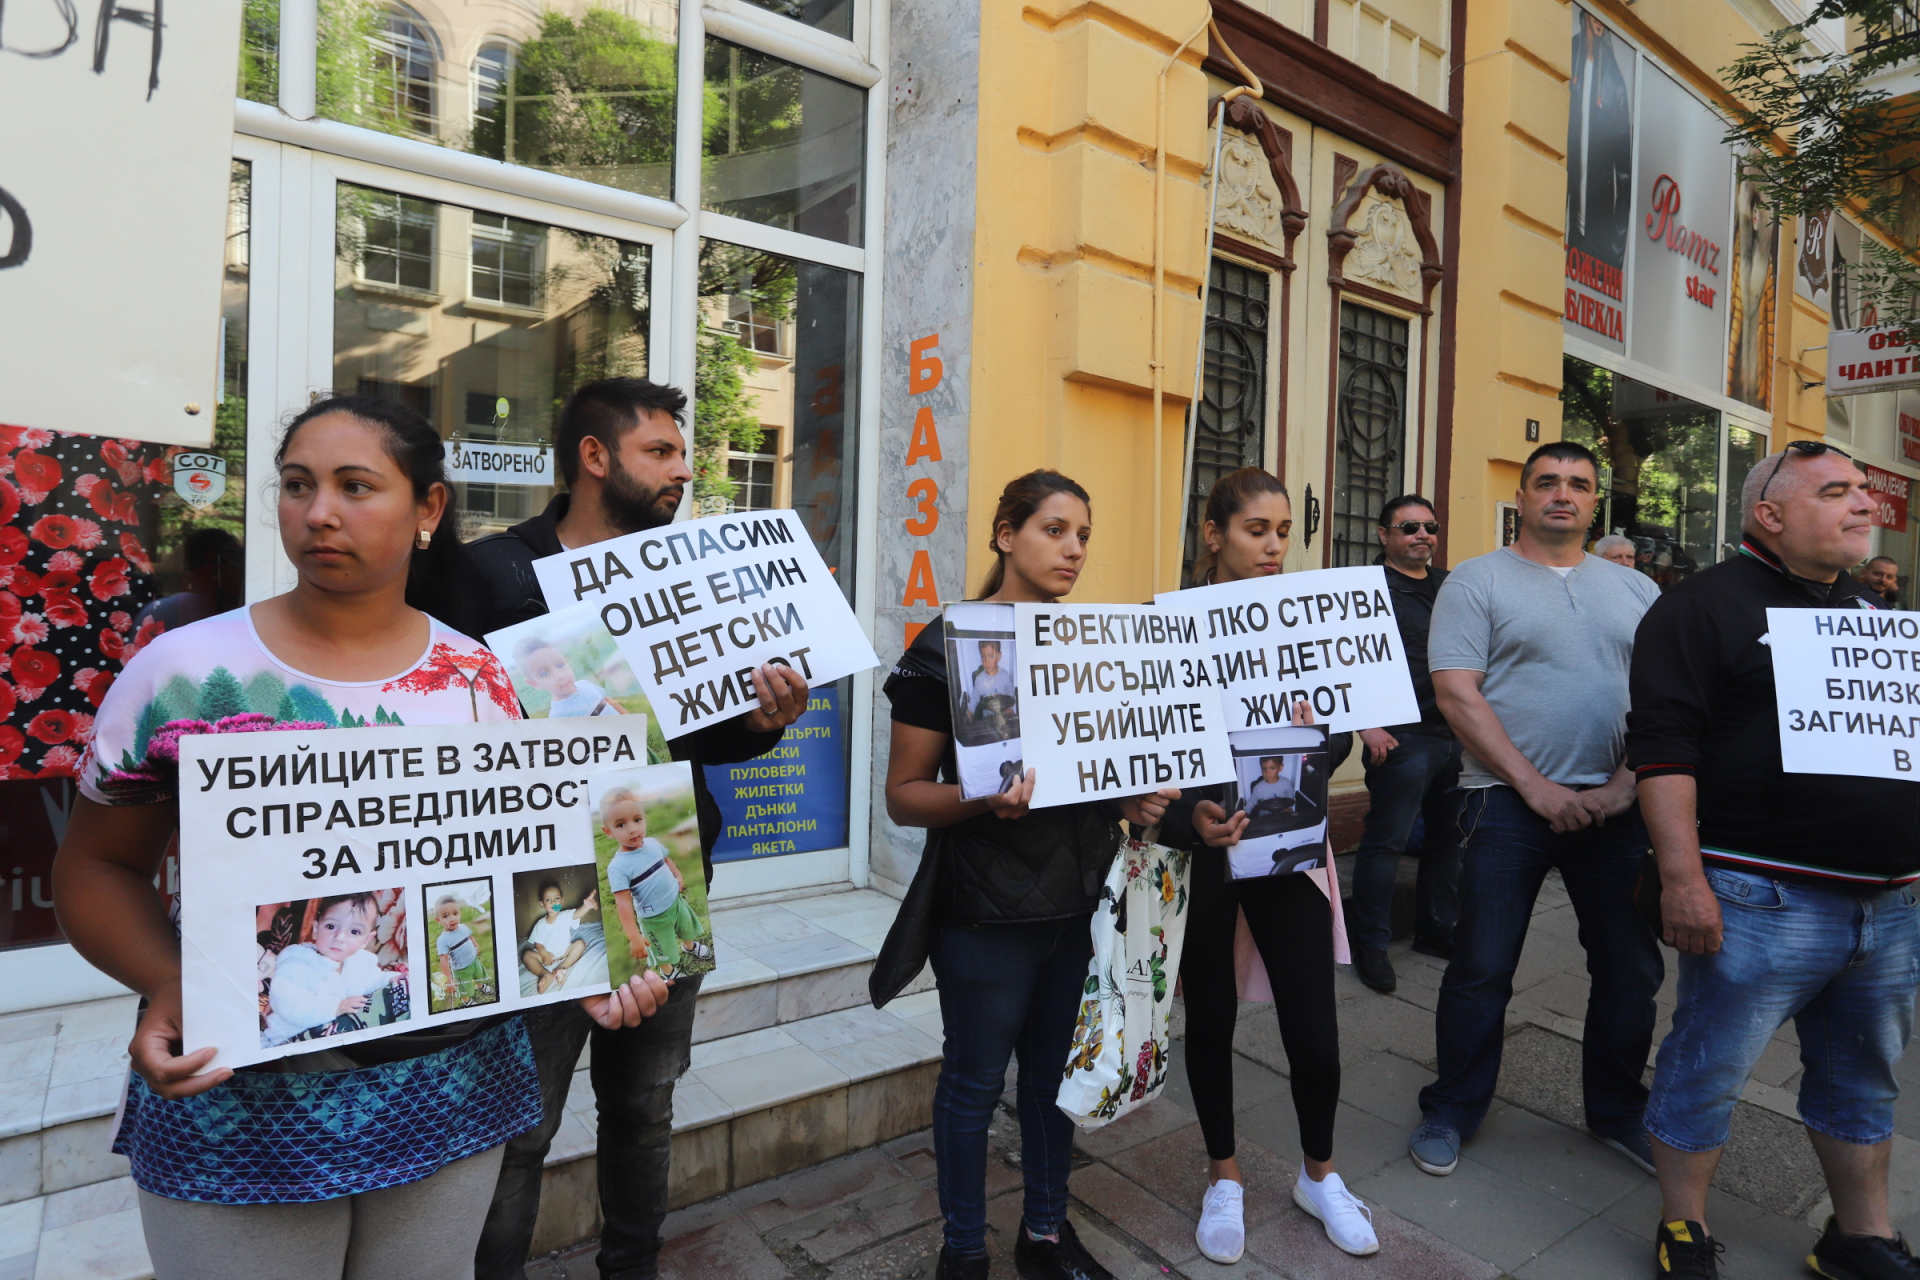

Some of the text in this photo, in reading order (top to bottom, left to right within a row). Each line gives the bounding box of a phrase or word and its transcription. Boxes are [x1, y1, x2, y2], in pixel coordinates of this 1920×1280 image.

[1646, 174, 1720, 275] Ramz
[1686, 276, 1716, 308] star
[1565, 287, 1623, 342] БЛЕКЛА
[1530, 422, 1537, 438] 9
[452, 450, 544, 474] ЗАТВОРЕНО
[570, 518, 795, 600] ДА СПАСИМ
[600, 557, 807, 636] ОЩЕ ЕДИН
[1207, 588, 1391, 639] ЛКО СТРУВА
[649, 602, 805, 685] ДЕТСКИ
[1035, 613, 1198, 647] ЕФЕКТИВНИ
[1815, 615, 1920, 641] НАЦИО
[1031, 658, 1212, 697] ПРИСЪДИ ЗА
[1212, 632, 1392, 690] ДИН ДЕТСКИ
[781, 727, 831, 740] ШЪРТИ
[1052, 700, 1205, 745] УБИЙЦИТЕ
[196, 734, 635, 792] УБИЙЦИТЕ В ЗАТВОРА
[730, 765, 806, 781] ПУЛОВЕРИ
[1077, 748, 1206, 793] НА ПЪТЯ
[1893, 749, 1912, 772] В
[226, 779, 588, 839] СПРАВЕДЛИВОС
[734, 783, 804, 799] ЖИЛЕТКИ
[727, 819, 817, 838] ПАНТАЛОНИ
[745, 802, 797, 820] ДЪНКИ
[302, 824, 556, 880] ЗА ЛЮДМИЛ
[752, 840, 796, 855] ЯКЕТА
